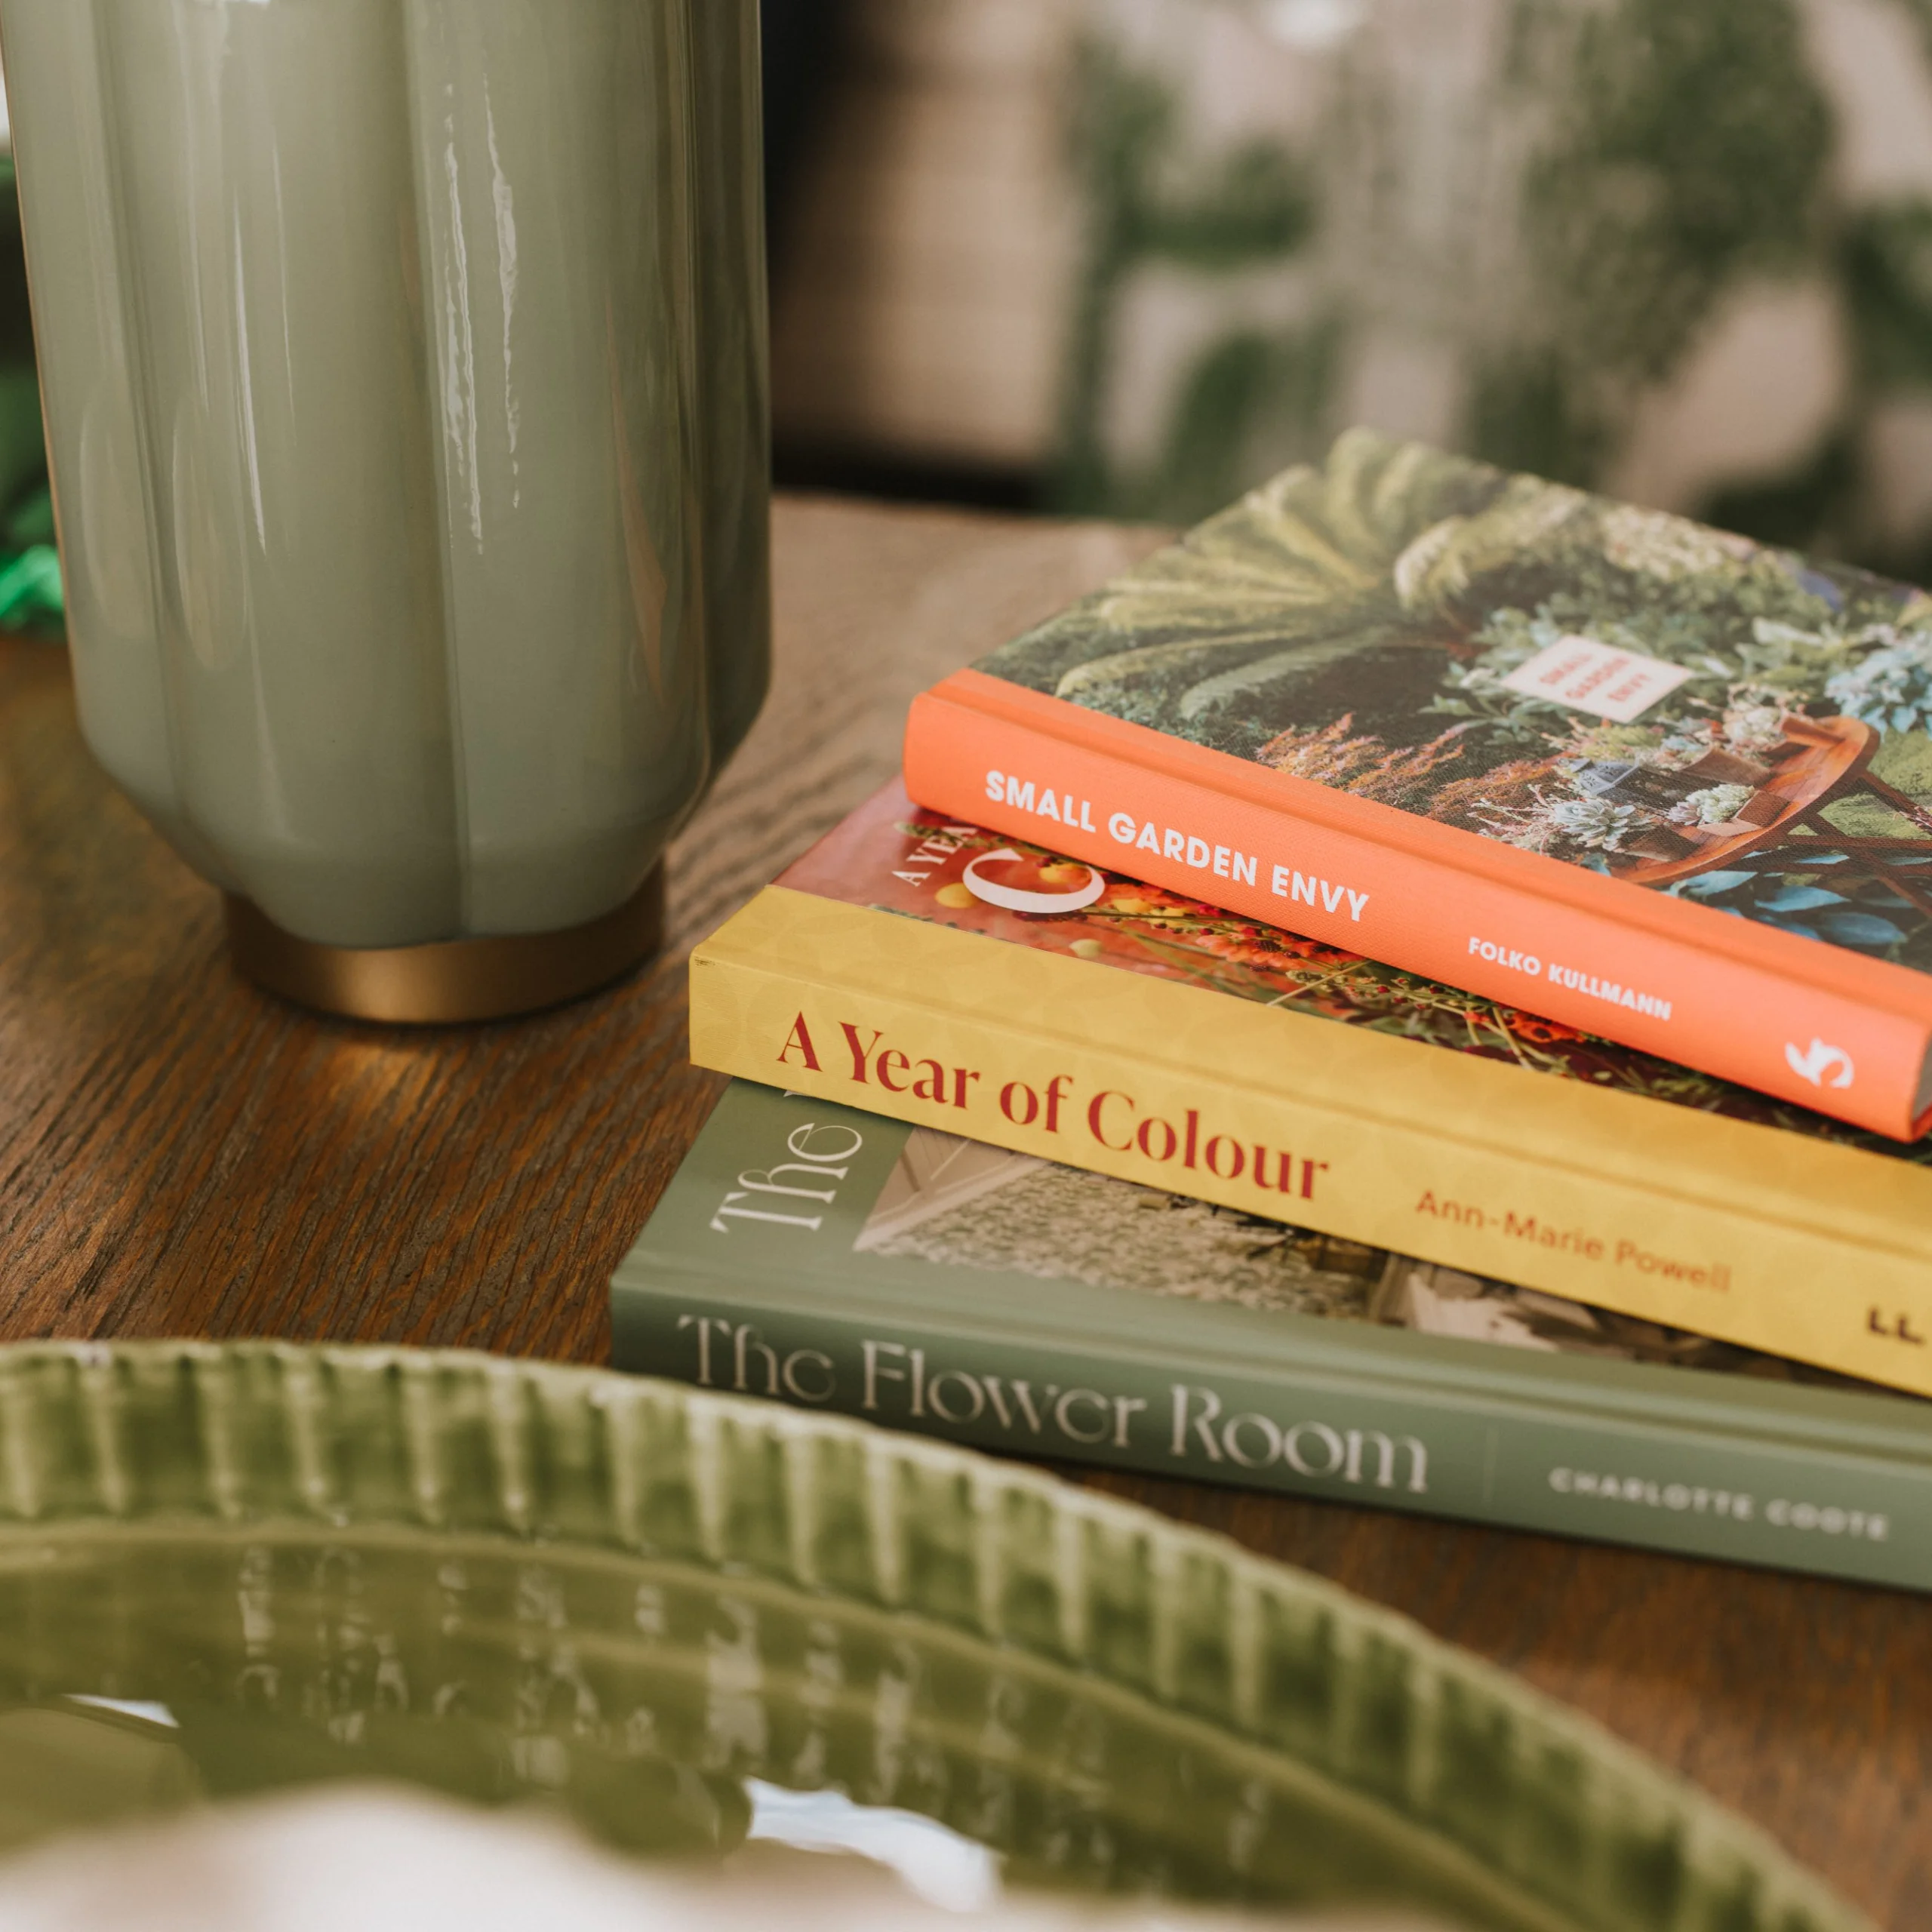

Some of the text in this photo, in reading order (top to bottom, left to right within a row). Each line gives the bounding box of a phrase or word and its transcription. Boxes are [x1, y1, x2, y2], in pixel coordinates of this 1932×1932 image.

[891, 826, 979, 888] A YEA
[985, 770, 1370, 922] SMALL GARDEN ENVY
[1468, 936, 1673, 1022] FOLKO KULLMANN
[777, 1011, 1330, 1201] A Year of Colour
[709, 1122, 863, 1234] The
[1414, 1189, 1733, 1294] Ann-Marie Powell
[677, 1315, 1430, 1494] The Flower Room
[1547, 1466, 1754, 1522] CHARLOTTE
